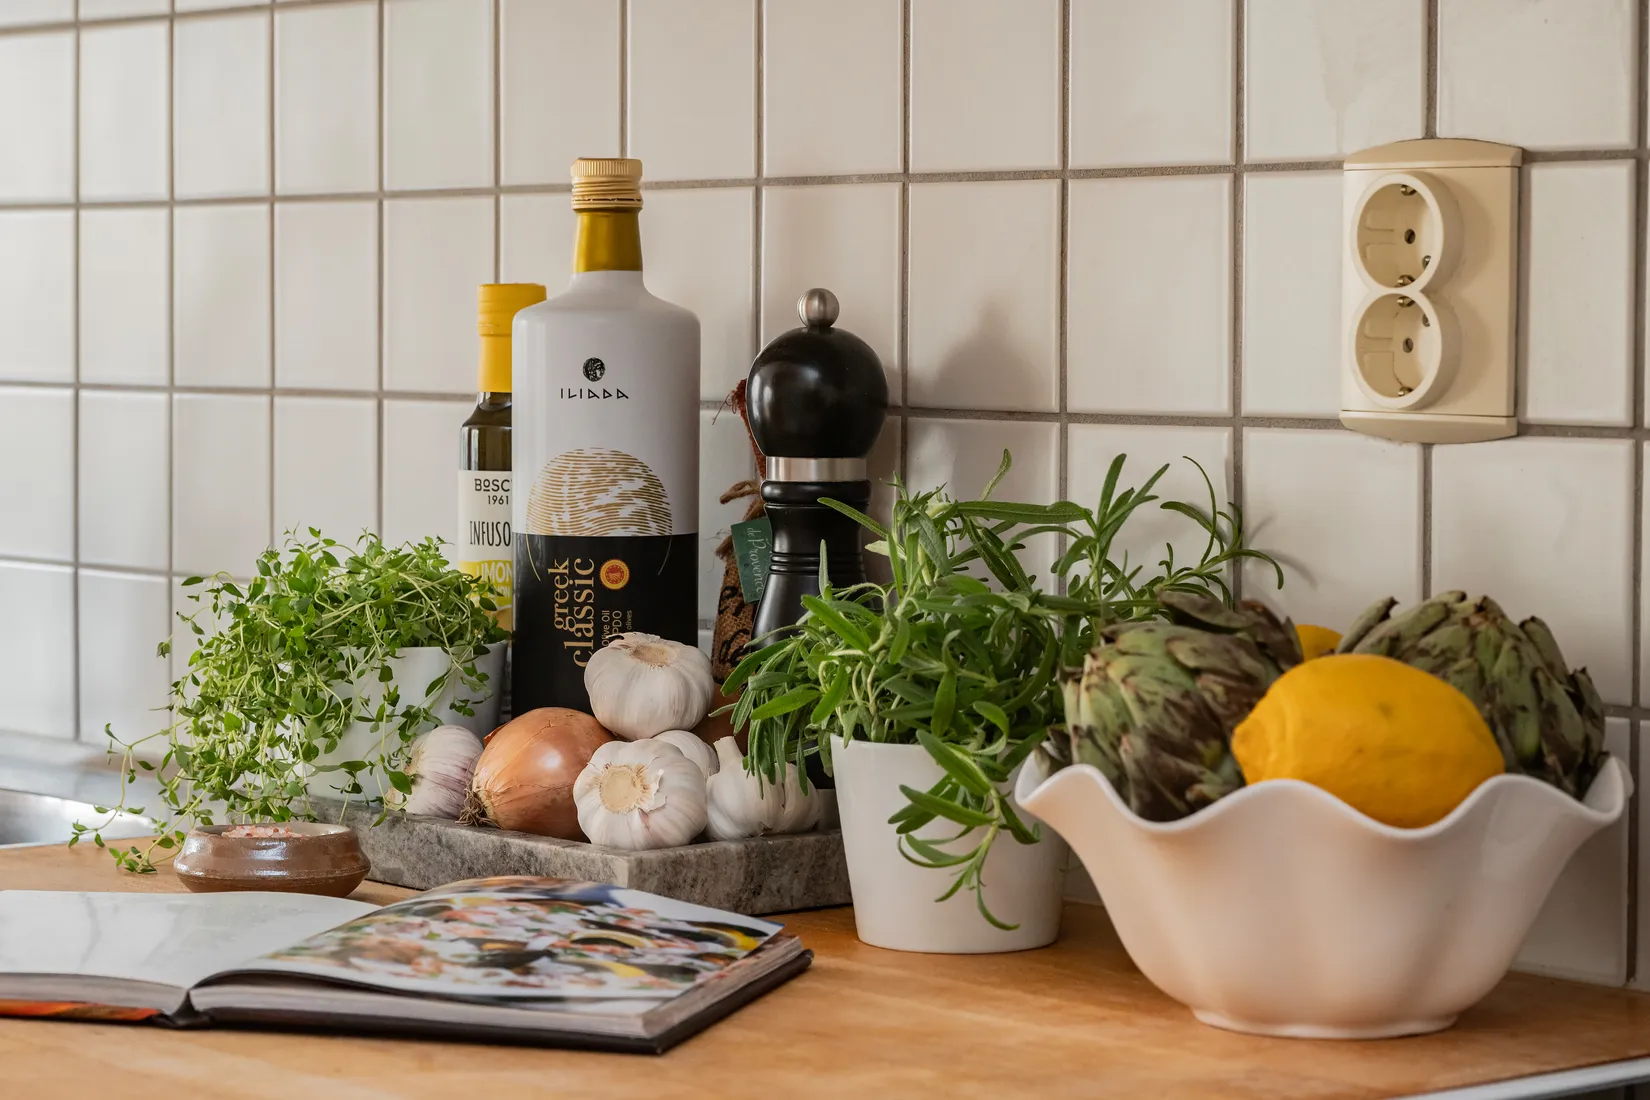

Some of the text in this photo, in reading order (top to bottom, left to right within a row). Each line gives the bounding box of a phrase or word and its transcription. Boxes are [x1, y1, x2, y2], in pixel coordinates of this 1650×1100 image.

[474, 478, 512, 492] BOSC
[487, 494, 509, 505] 1961
[469, 520, 511, 547] INFUSO
[547, 557, 577, 632] greek
[563, 558, 595, 668] classic
[601, 610, 610, 622] Oil
